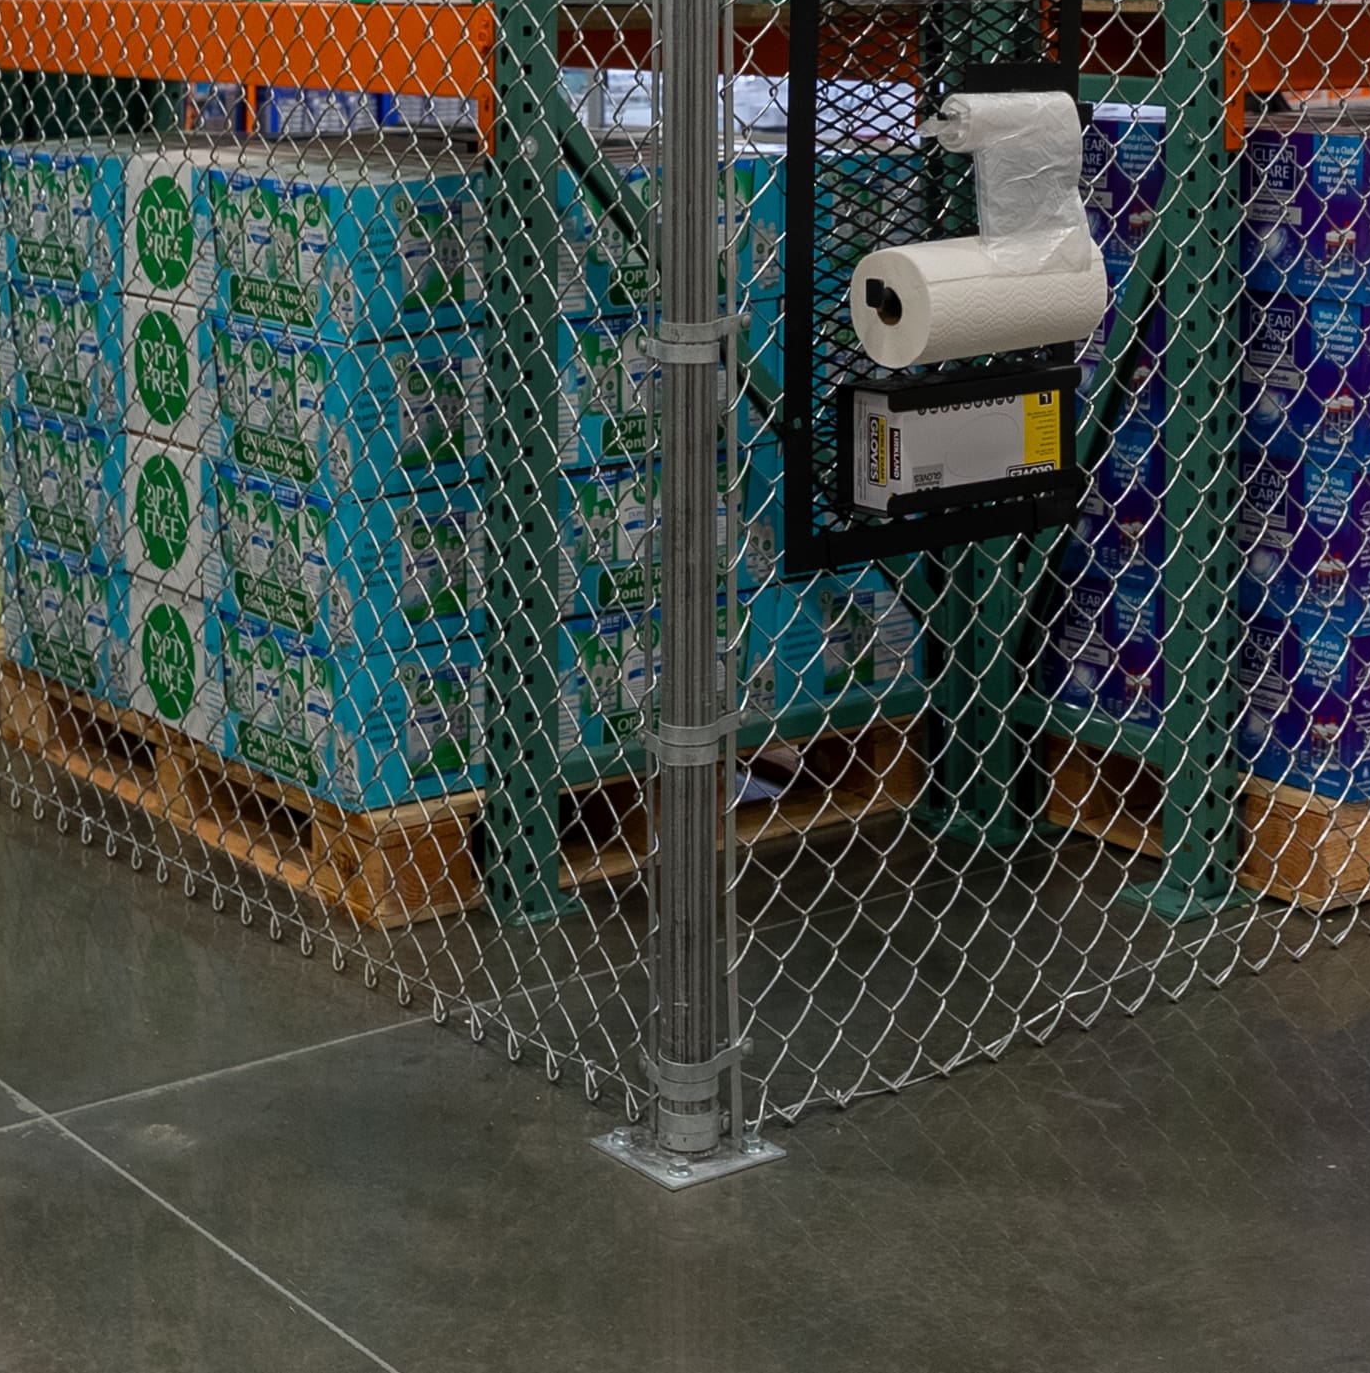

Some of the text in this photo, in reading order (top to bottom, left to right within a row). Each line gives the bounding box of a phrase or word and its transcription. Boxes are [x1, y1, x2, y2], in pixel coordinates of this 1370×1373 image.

[1253, 147, 1294, 163] CLEAR
[146, 232, 183, 262] FREE
[144, 369, 180, 398] FREE
[870, 419, 879, 480] GLOVES
[144, 510, 180, 543] FREE
[150, 656, 186, 695] FREE
